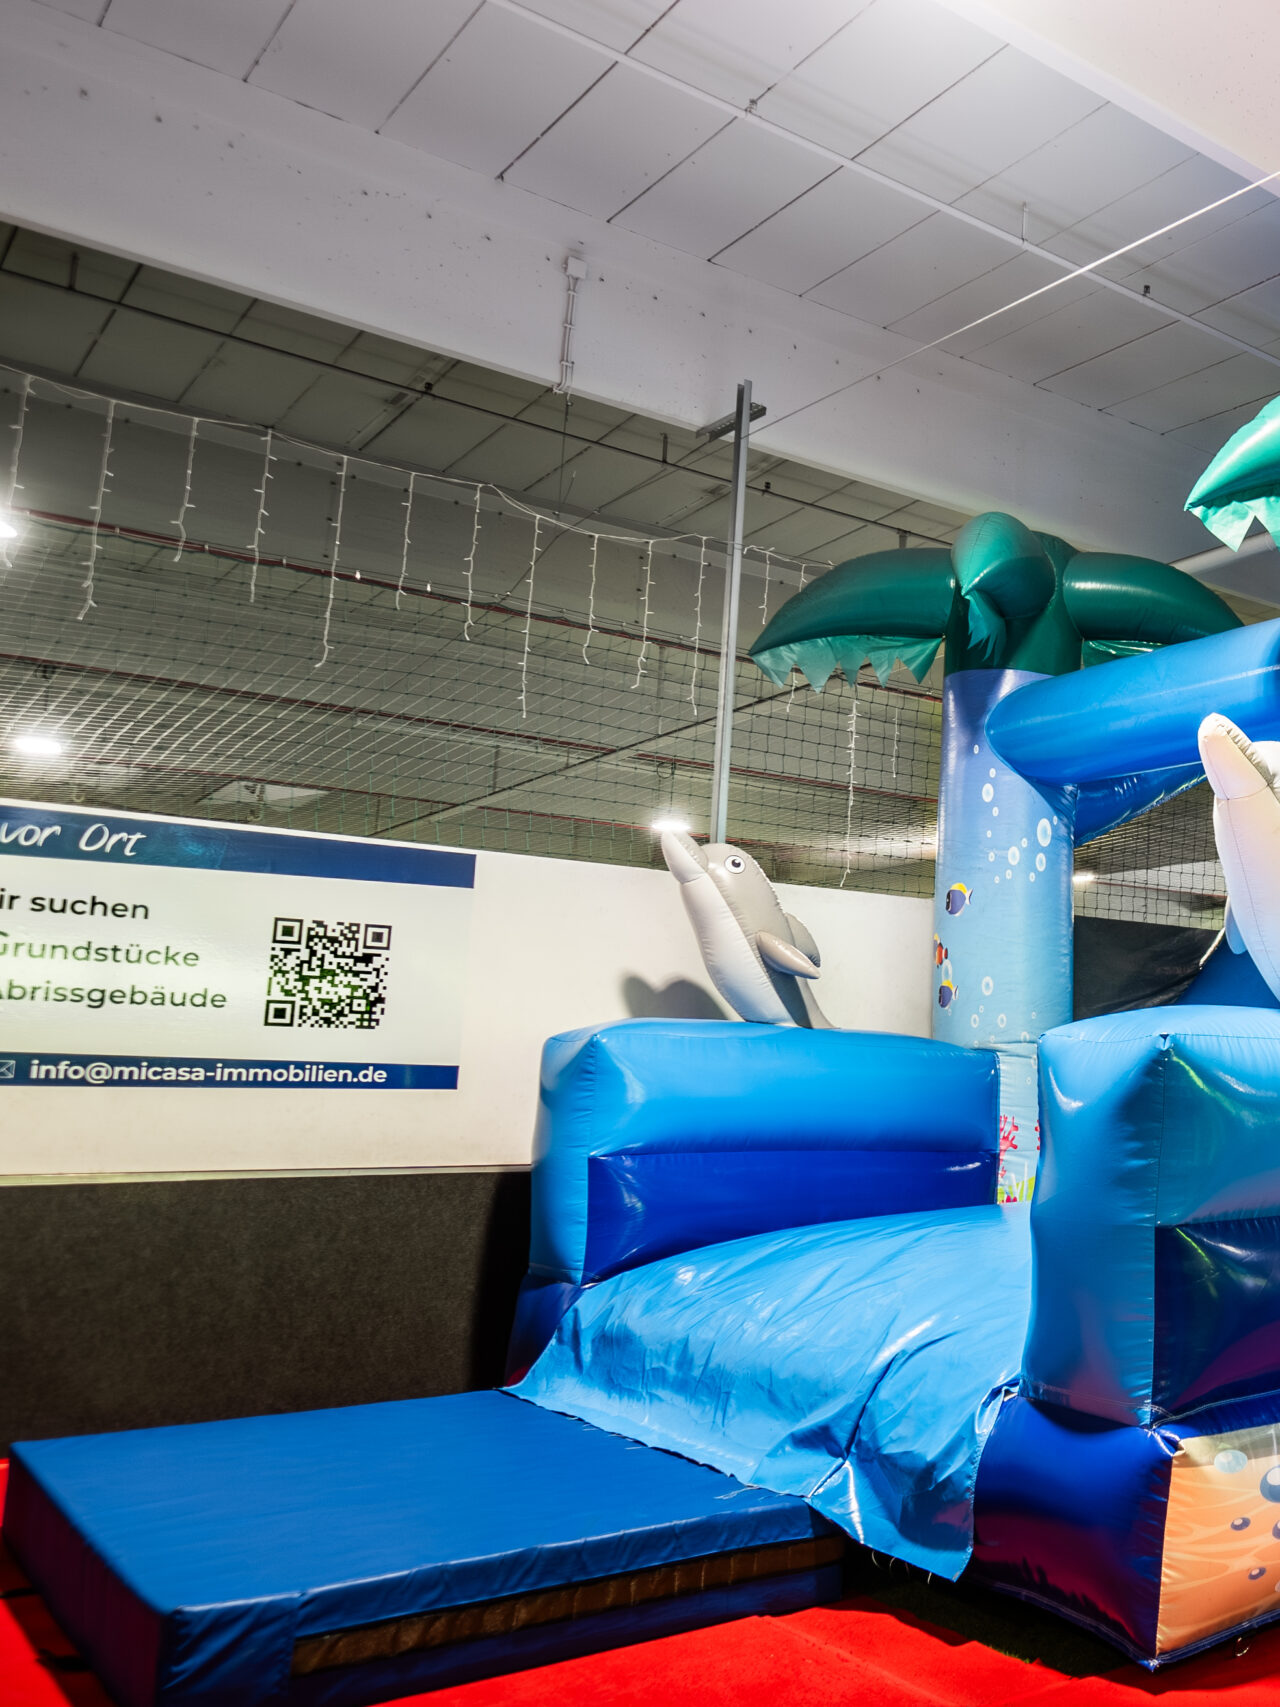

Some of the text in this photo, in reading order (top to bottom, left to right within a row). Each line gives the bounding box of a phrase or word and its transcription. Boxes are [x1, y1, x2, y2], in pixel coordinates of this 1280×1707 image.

[0, 822, 147, 856] vor Ort
[30, 895, 149, 919] suchen
[0, 979, 227, 1009] brissgebäude
[29, 1059, 388, 1084] info@micasa-immobilien.de
